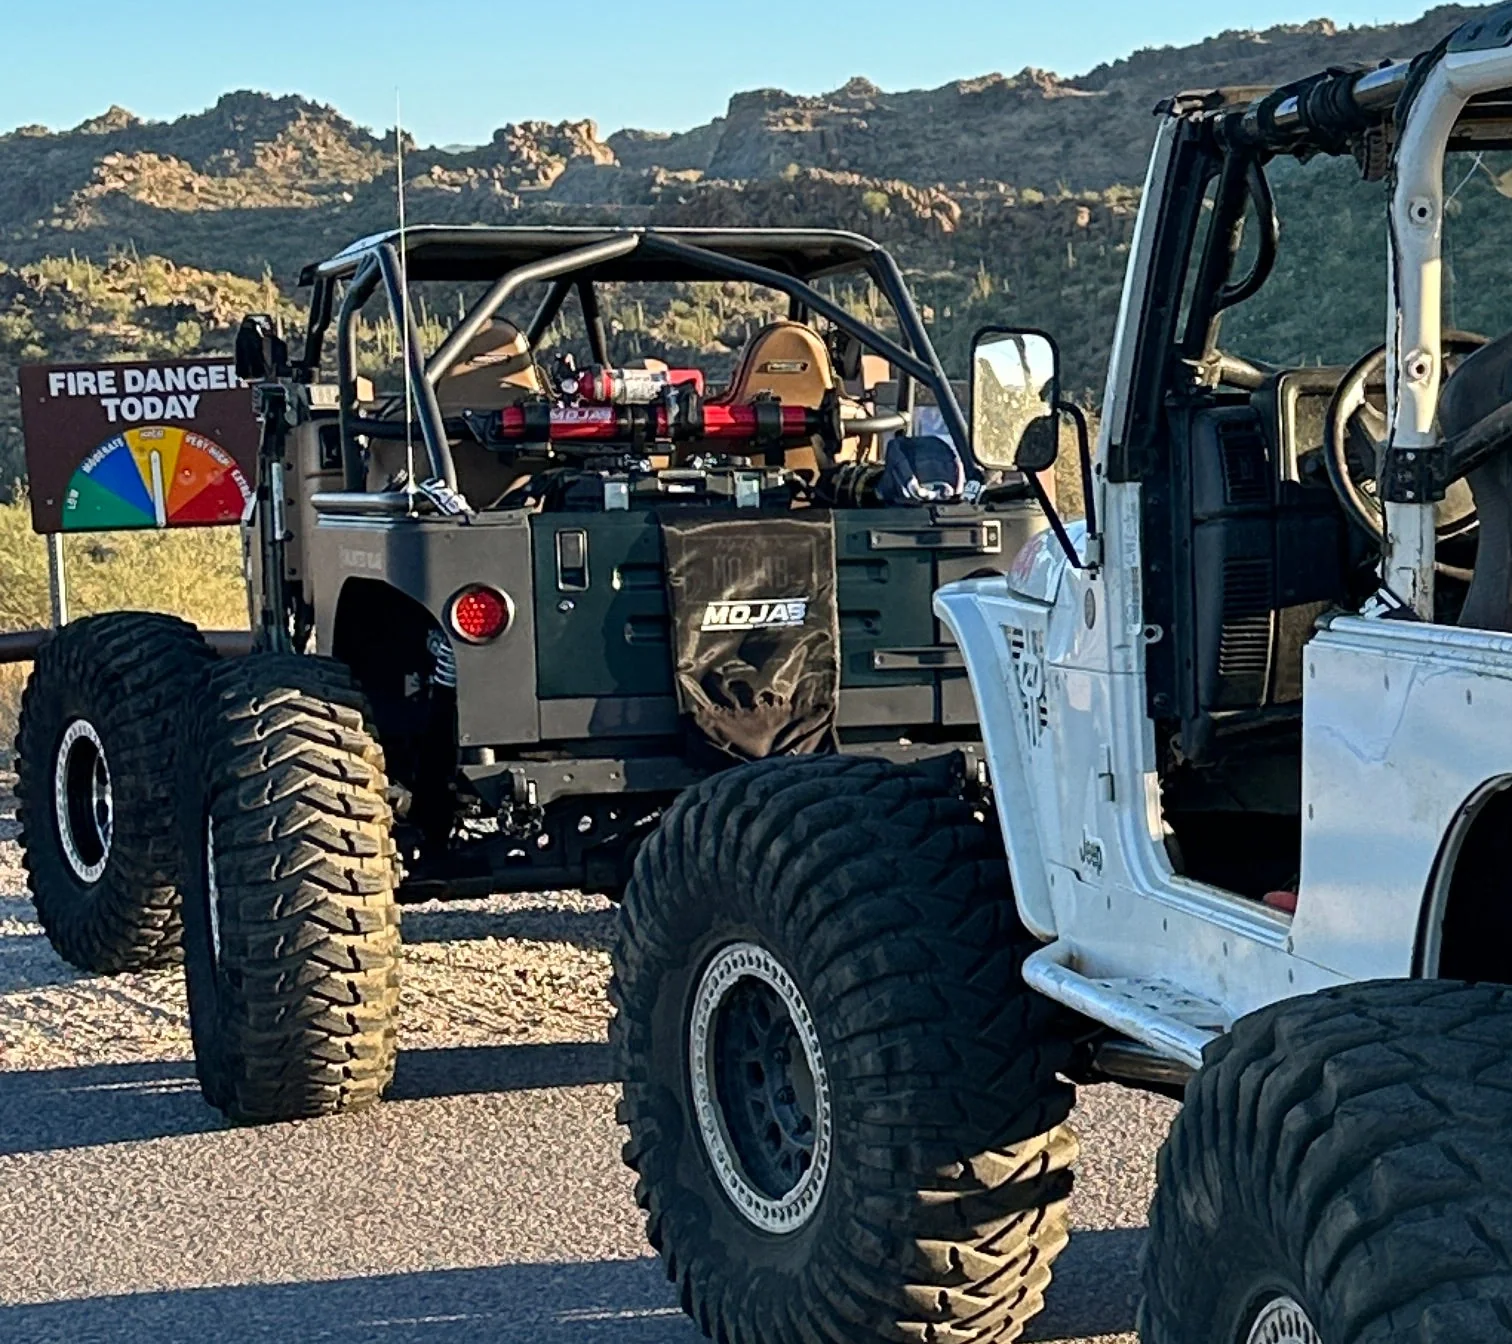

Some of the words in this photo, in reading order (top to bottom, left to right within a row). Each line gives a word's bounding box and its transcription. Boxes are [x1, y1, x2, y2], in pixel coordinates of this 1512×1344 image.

[49, 369, 117, 397] FIRE
[101, 394, 200, 422] TODAY
[66, 488, 80, 510] LOW
[702, 603, 806, 625] MOJAB
